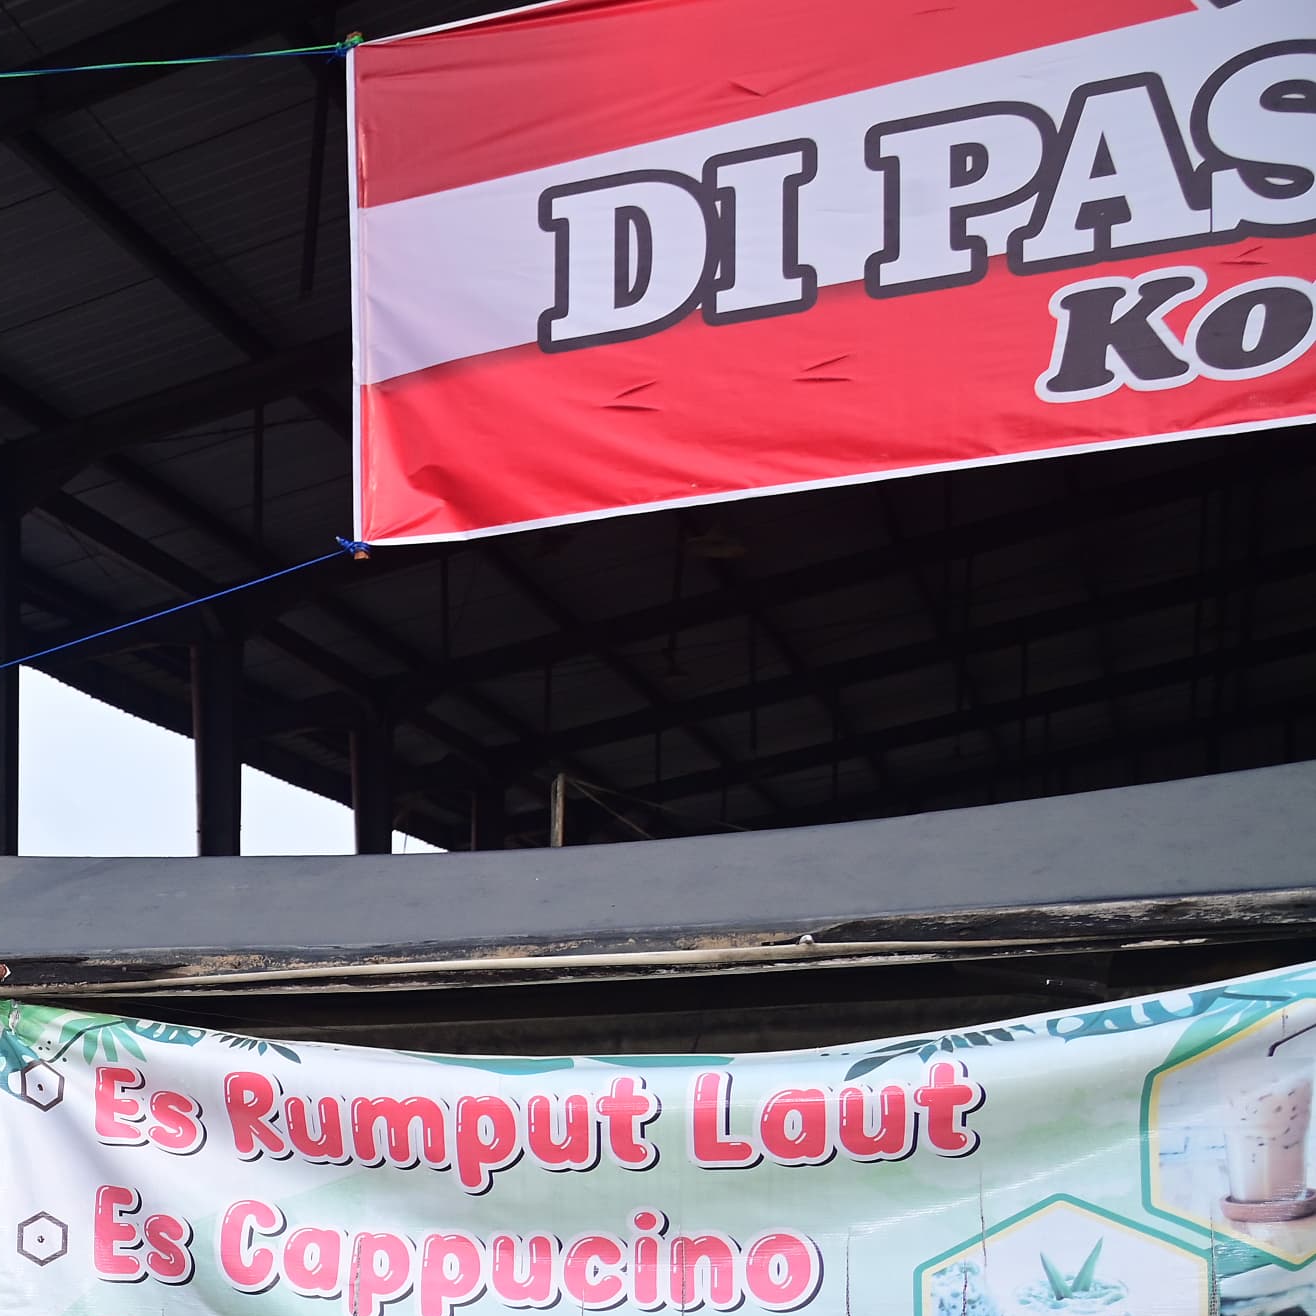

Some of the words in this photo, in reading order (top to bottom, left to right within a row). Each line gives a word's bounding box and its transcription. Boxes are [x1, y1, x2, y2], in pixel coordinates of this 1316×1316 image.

[538, 138, 817, 354] DI
[93, 1065, 207, 1155] Es
[222, 1067, 661, 1195] Rumput
[687, 1058, 984, 1170] Laut
[91, 1183, 194, 1286] Es
